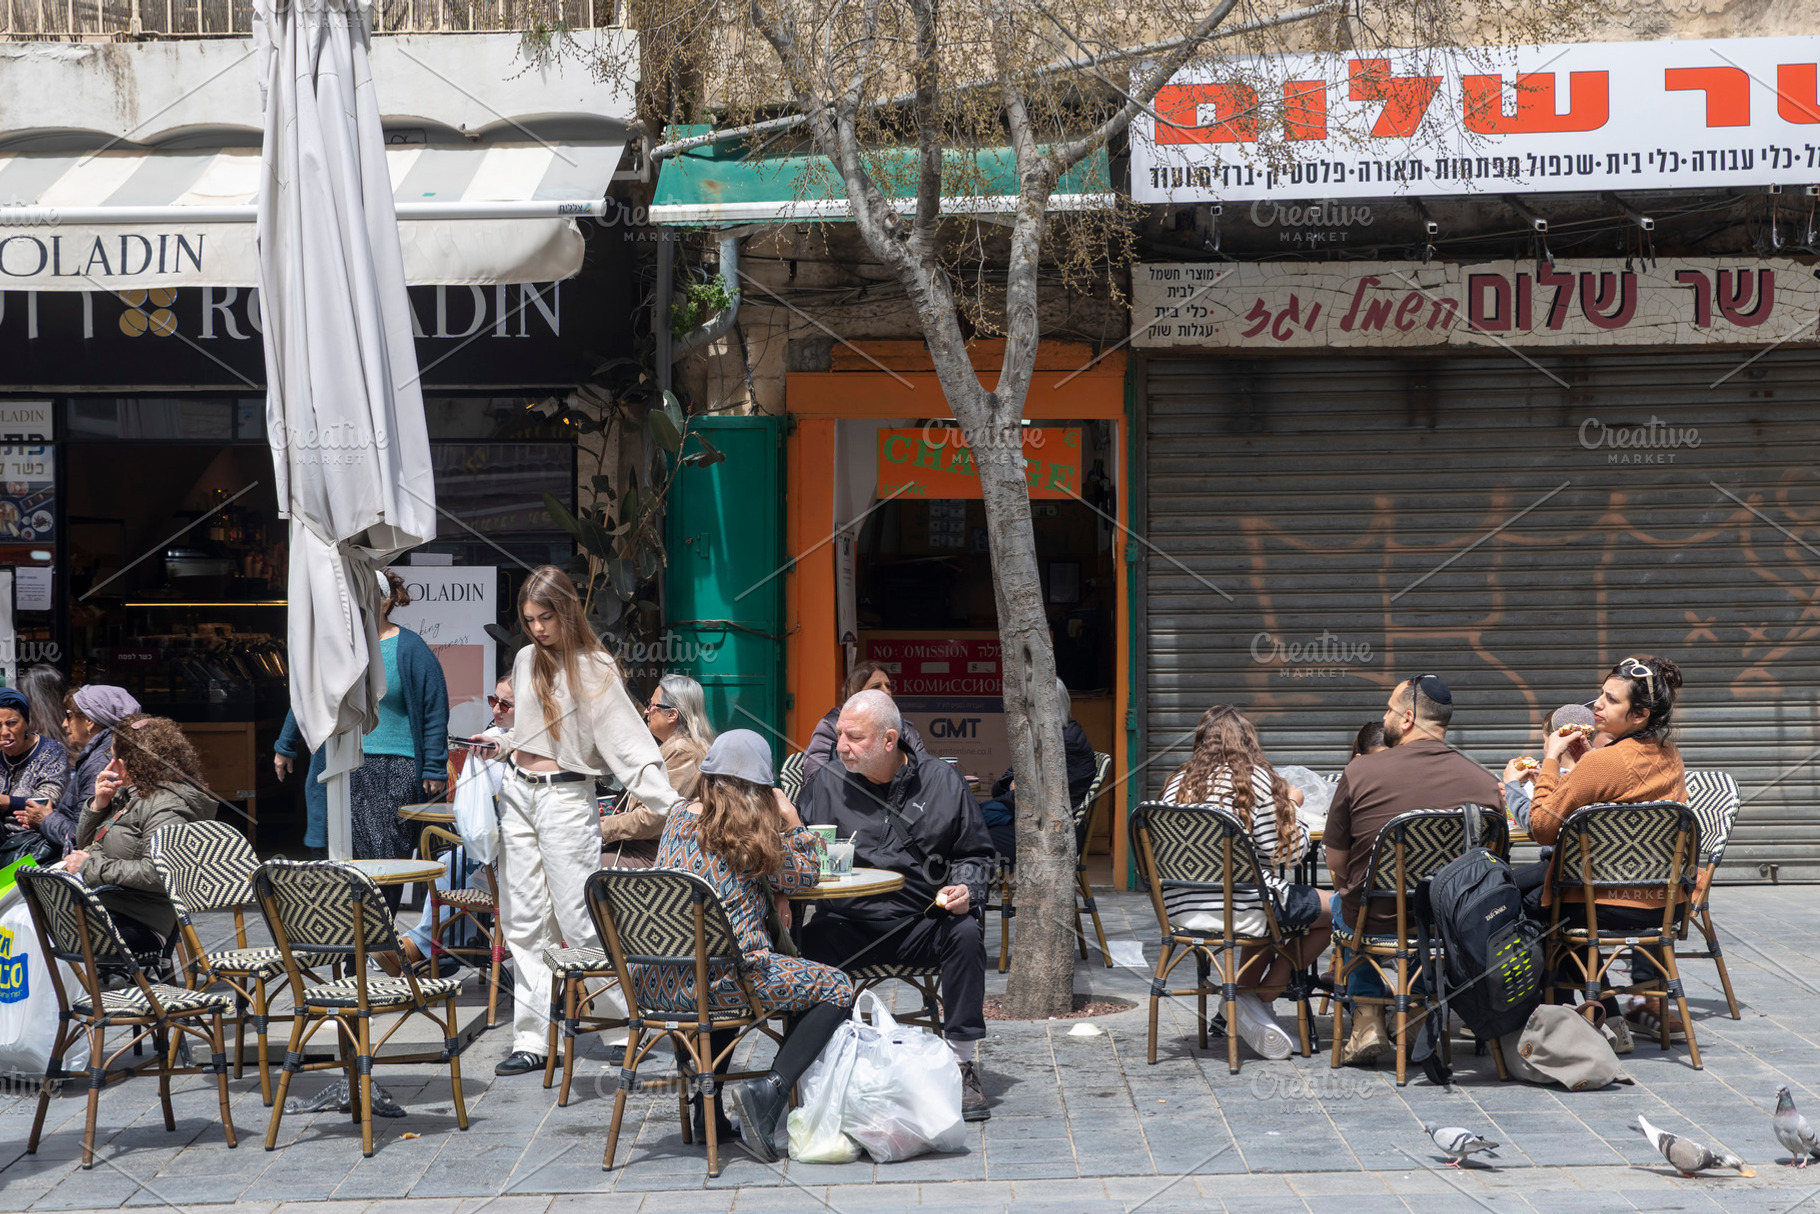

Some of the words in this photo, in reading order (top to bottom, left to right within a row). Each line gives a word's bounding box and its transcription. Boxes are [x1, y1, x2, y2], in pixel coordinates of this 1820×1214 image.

[1154, 59, 1608, 145] שלום
[1665, 63, 1820, 127] ר
[1526, 152, 1594, 177] שכפול
[1606, 152, 1642, 174] בית
[1649, 148, 1679, 172] כלי
[1691, 149, 1754, 171] עבודה
[1761, 144, 1792, 169] כלי
[1358, 158, 1423, 182] תאורה
[1435, 156, 1520, 180] מפתחות
[1149, 266, 1180, 280] חשמל
[1186, 268, 1214, 280] מוצרי
[1167, 284, 1194, 297] לבית
[1468, 261, 1638, 331] שלום
[1675, 268, 1775, 328] שר
[1155, 306, 1179, 318] בית
[1186, 304, 1208, 318] כלי
[1340, 277, 1459, 332] חשמל
[1148, 324, 1171, 340] שוק
[1178, 322, 1213, 338] עגלות
[12, 463, 44, 475] כשר
[883, 434, 1075, 493] CHAGE
[873, 645, 892, 657] NO
[929, 718, 981, 738] GMT
